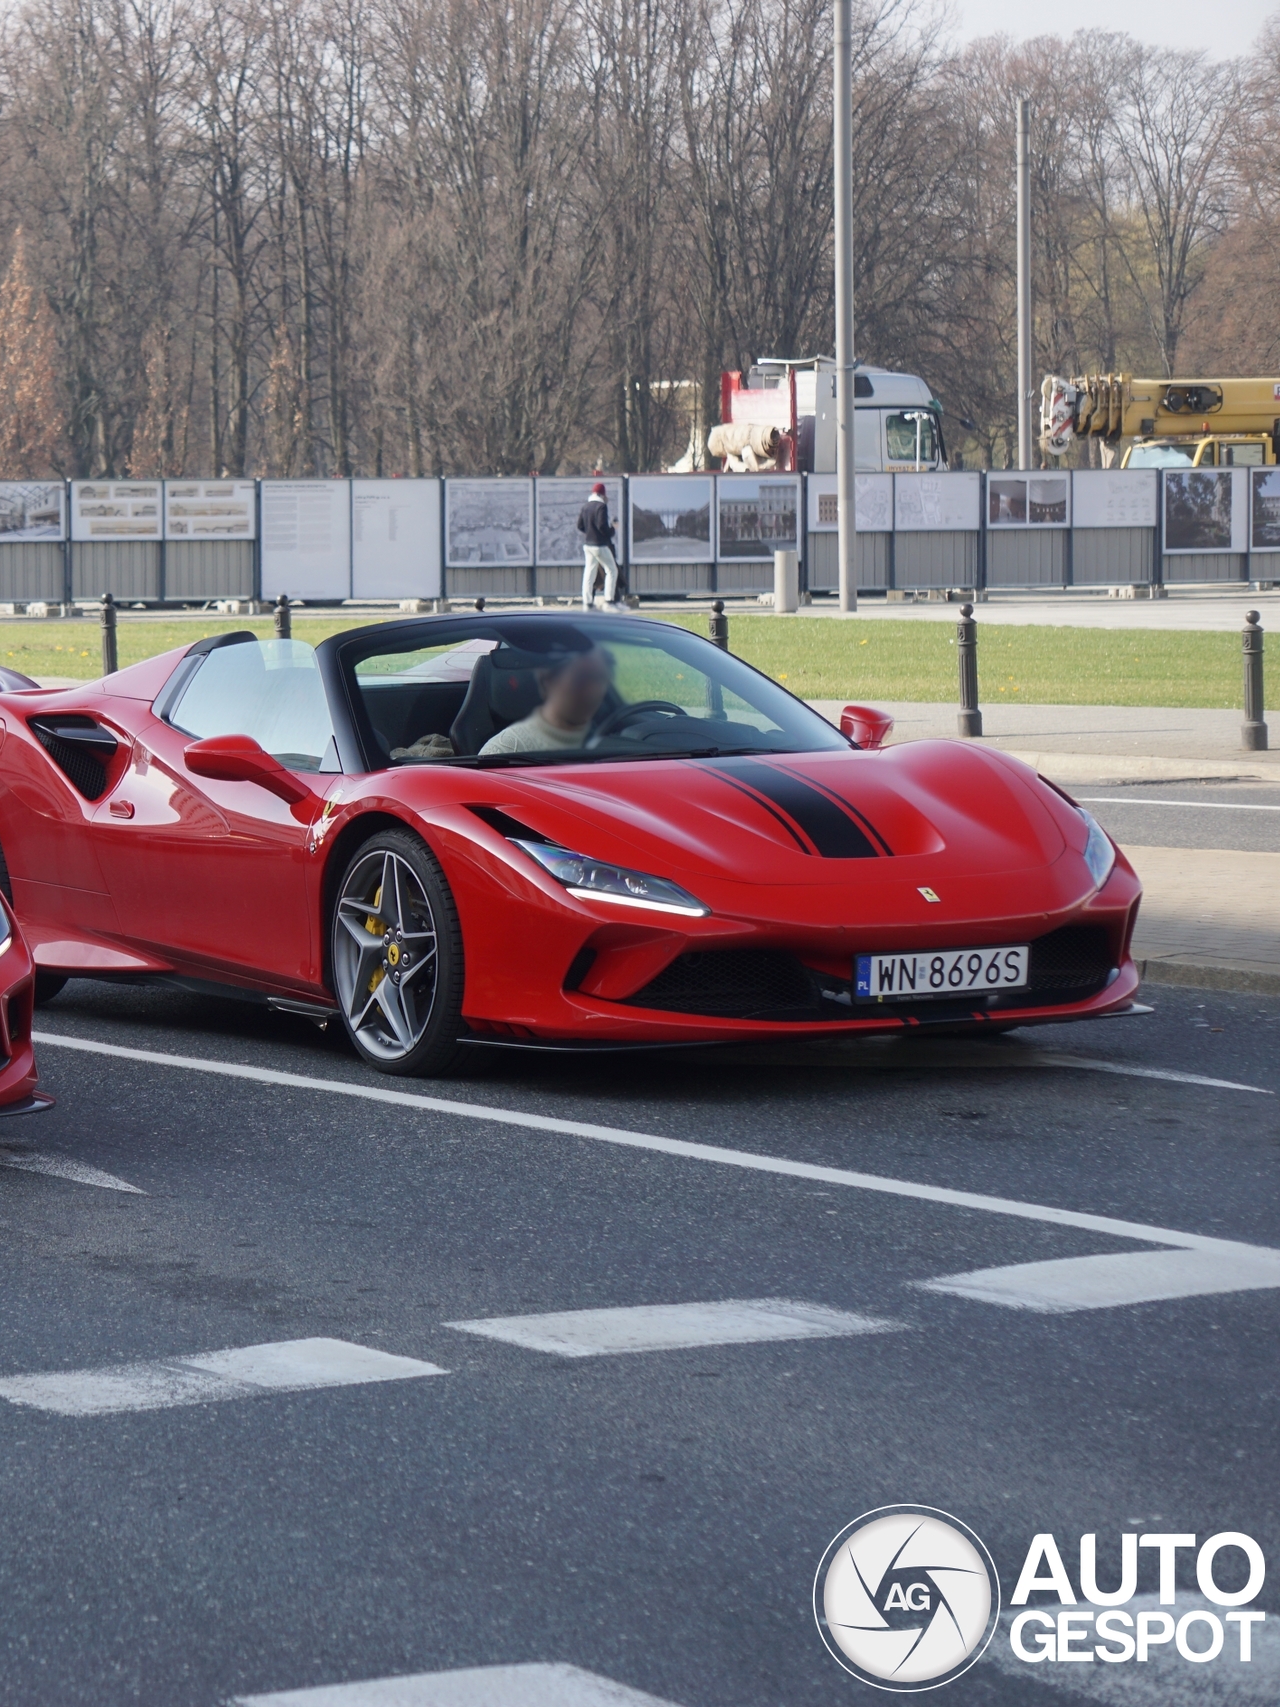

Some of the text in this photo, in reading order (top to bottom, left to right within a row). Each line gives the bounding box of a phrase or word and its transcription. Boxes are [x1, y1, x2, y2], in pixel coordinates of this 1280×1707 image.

[878, 951, 1021, 992] WN 8696S
[857, 981, 869, 991] PL
